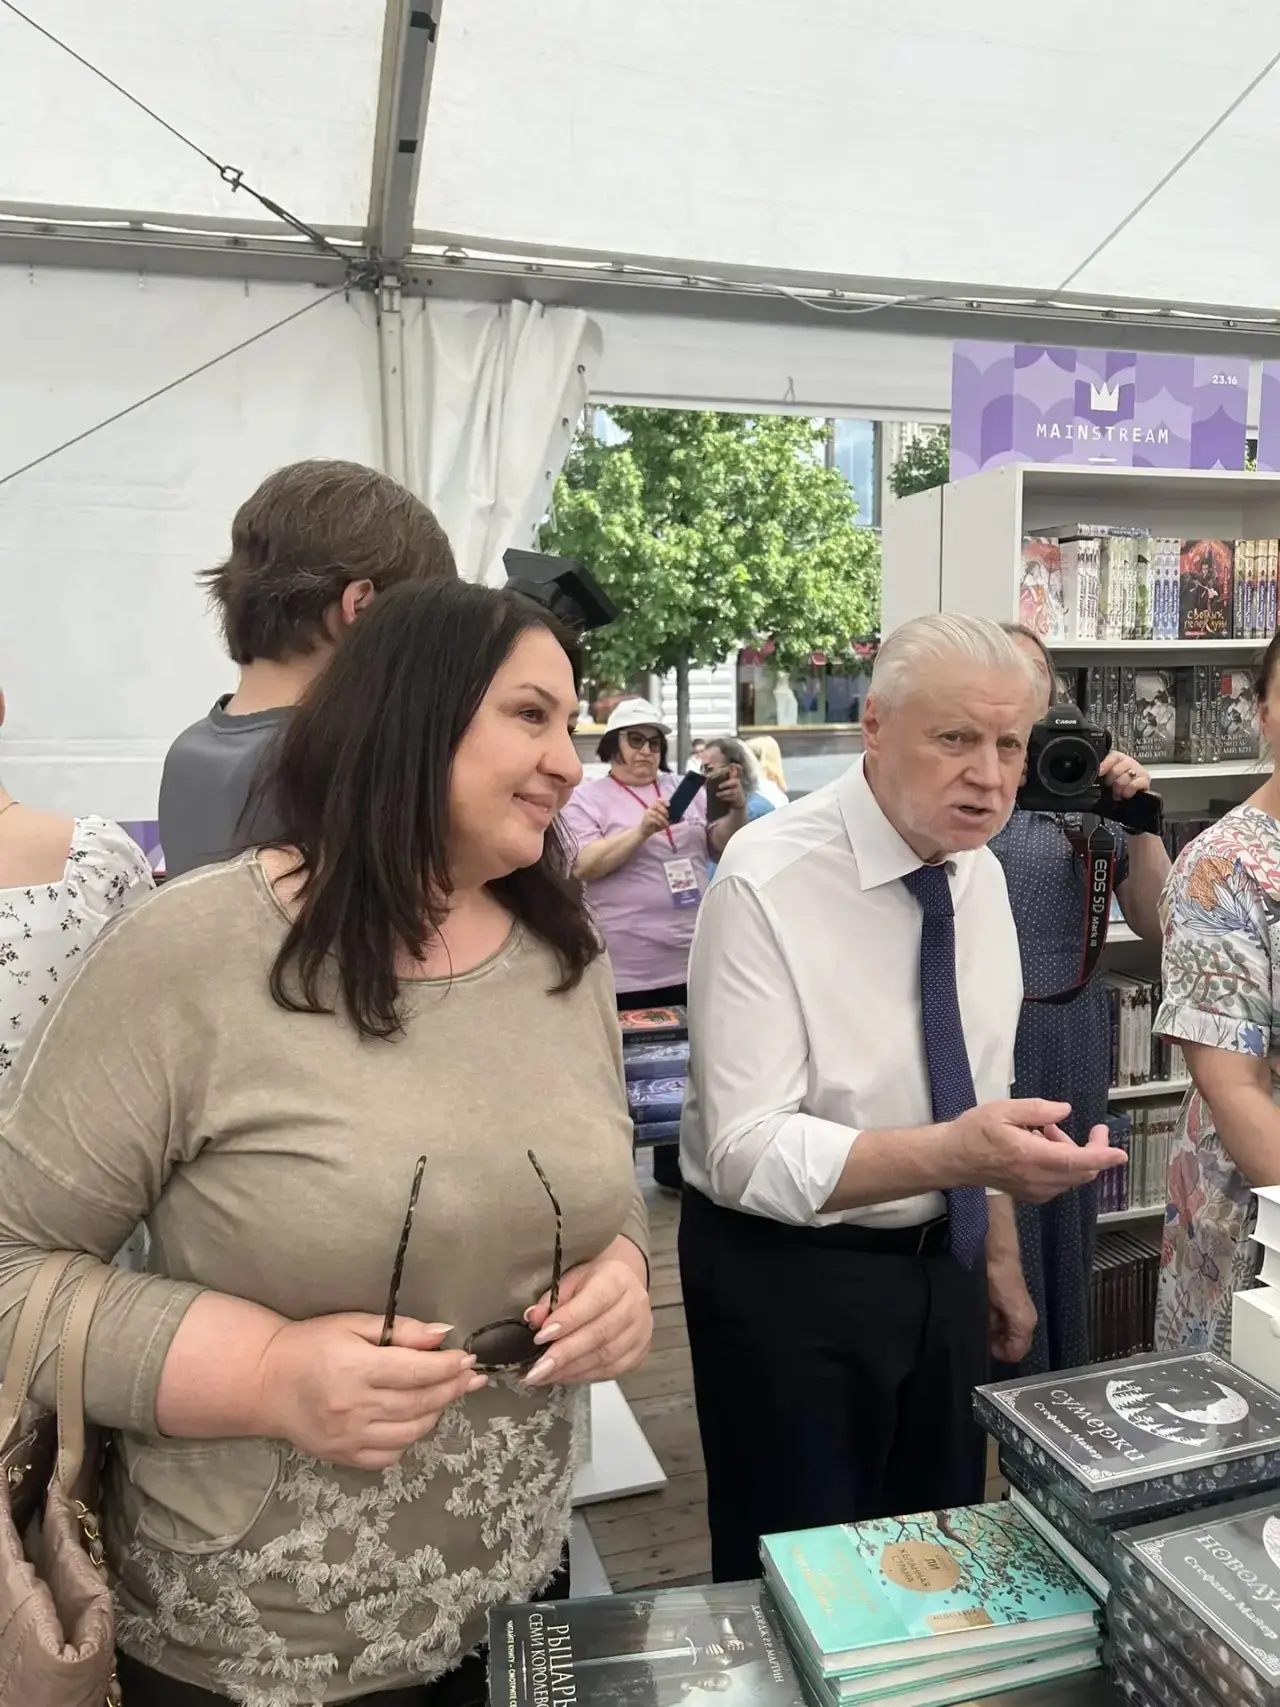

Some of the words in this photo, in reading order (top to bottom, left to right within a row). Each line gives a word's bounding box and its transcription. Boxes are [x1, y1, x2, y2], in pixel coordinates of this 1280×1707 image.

[1212, 374, 1238, 385] 23.16
[1036, 423, 1169, 444] MAINSTREAM
[1094, 859, 1108, 893] EOS
[1093, 896, 1105, 913] 5D
[1091, 916, 1099, 938] Mark
[1033, 1402, 1073, 1434] Стефани
[1070, 1433, 1103, 1460] Майер
[891, 1555, 914, 1583] СТРАНА
[924, 1557, 940, 1571] ЛИ
[1184, 1555, 1236, 1601] Стефани
[1234, 1601, 1278, 1639] Майер
[528, 1613, 545, 1647] СЕМИ
[750, 1604, 770, 1637] ДЖОРДЖ
[766, 1649, 784, 1683] МАРТИН
[508, 1644, 516, 1663] КНИГУ
[508, 1668, 517, 1699] СМОТРИТЕ
